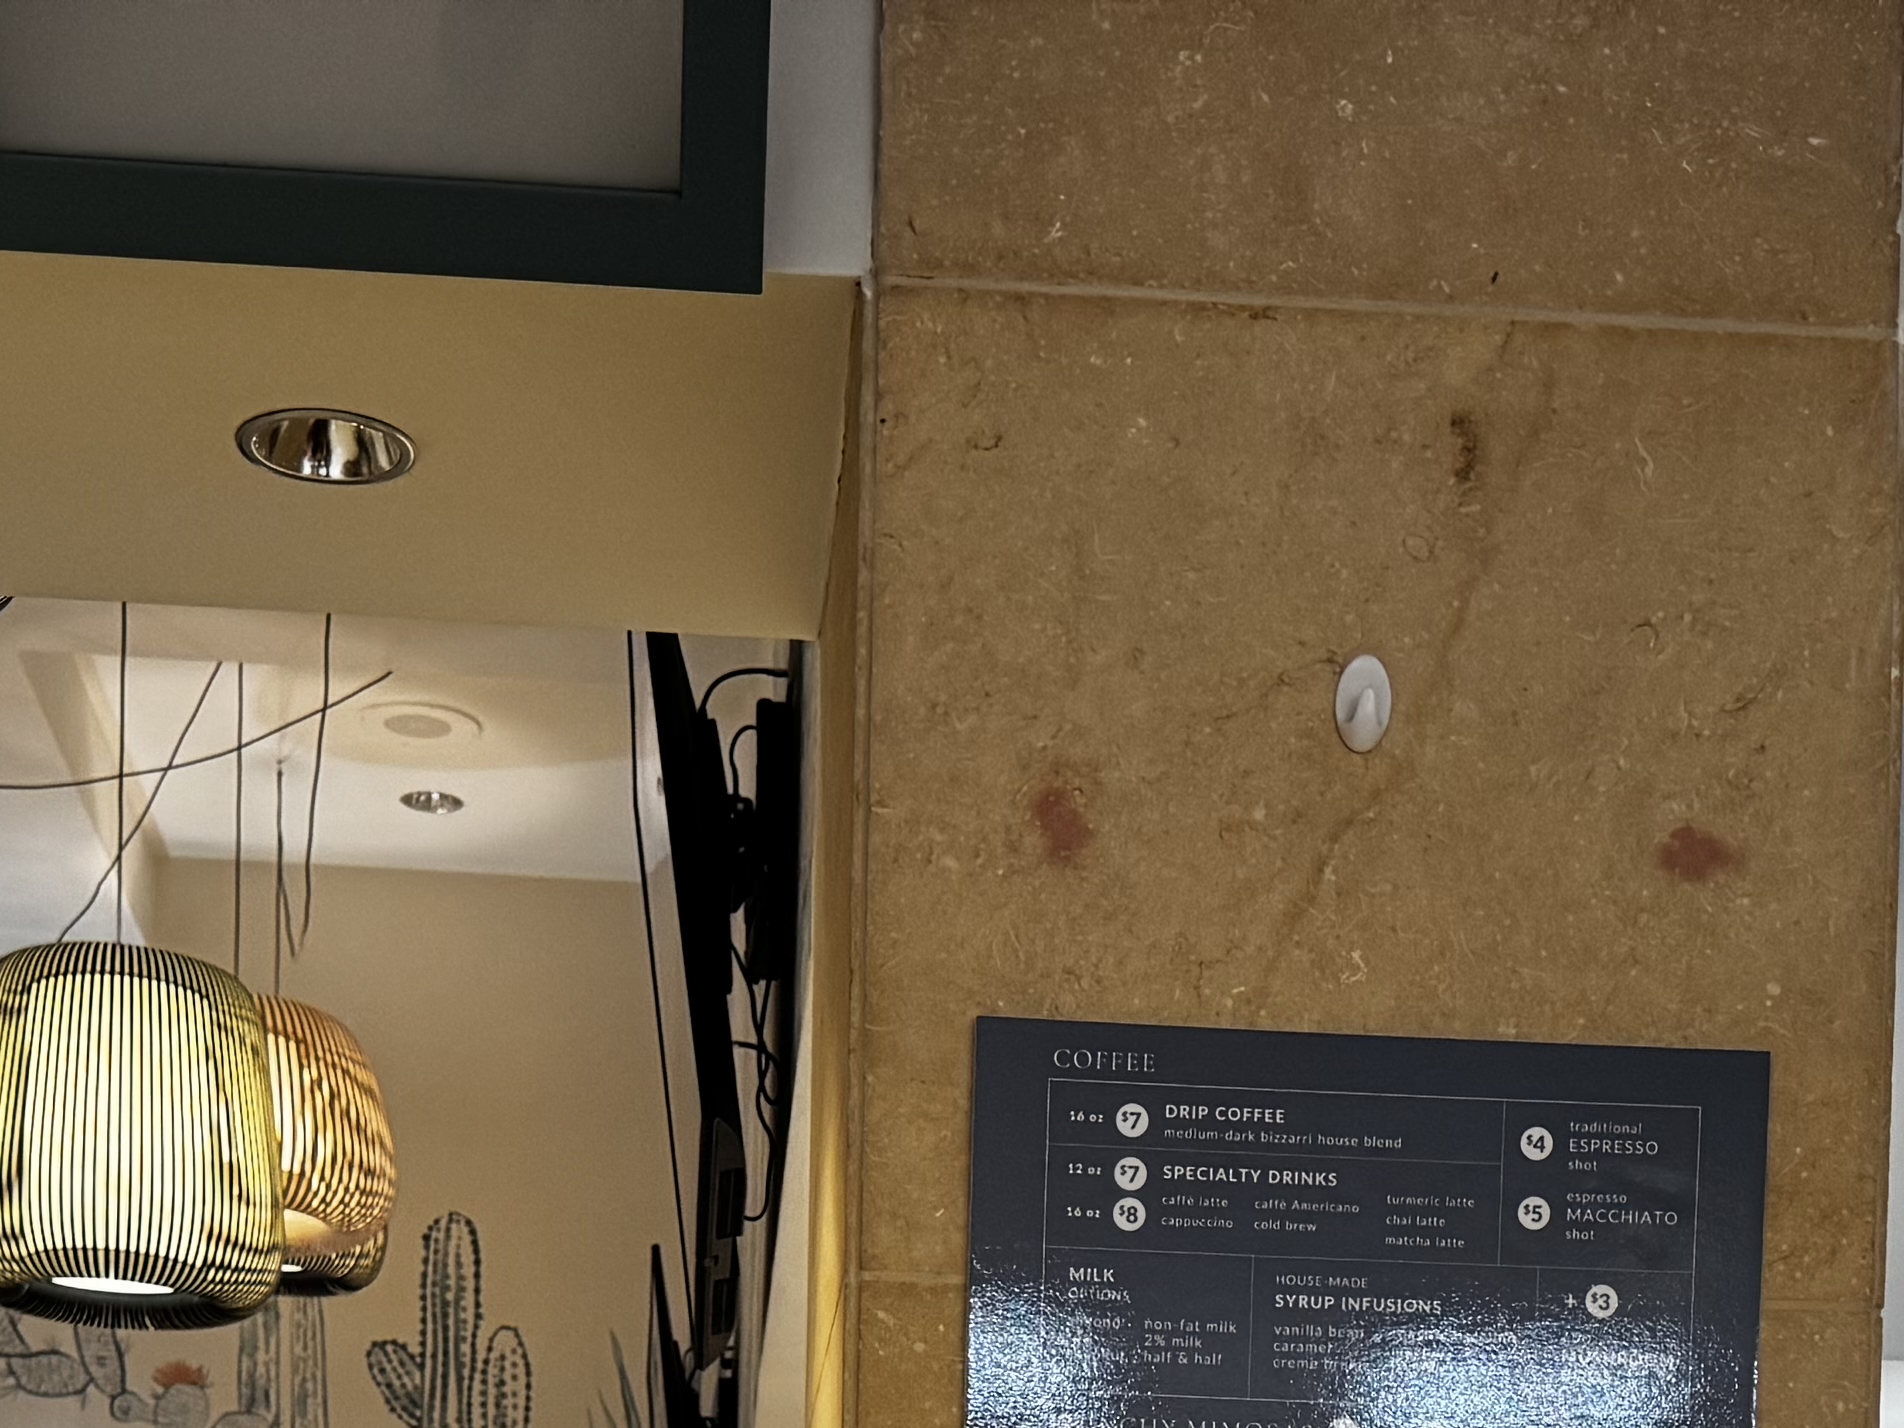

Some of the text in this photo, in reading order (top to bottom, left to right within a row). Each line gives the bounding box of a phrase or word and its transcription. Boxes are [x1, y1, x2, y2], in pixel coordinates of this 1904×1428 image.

[1054, 1049, 1154, 1071] COFFEE
[1122, 1104, 1284, 1130] $7 DRIP COFFEE
[1527, 1134, 1657, 1154] $4 ESPRESSO
[1120, 1165, 1336, 1186] $7 SPECIALTY DRINKS
[1524, 1204, 1678, 1226] $5 MACCHIATO
